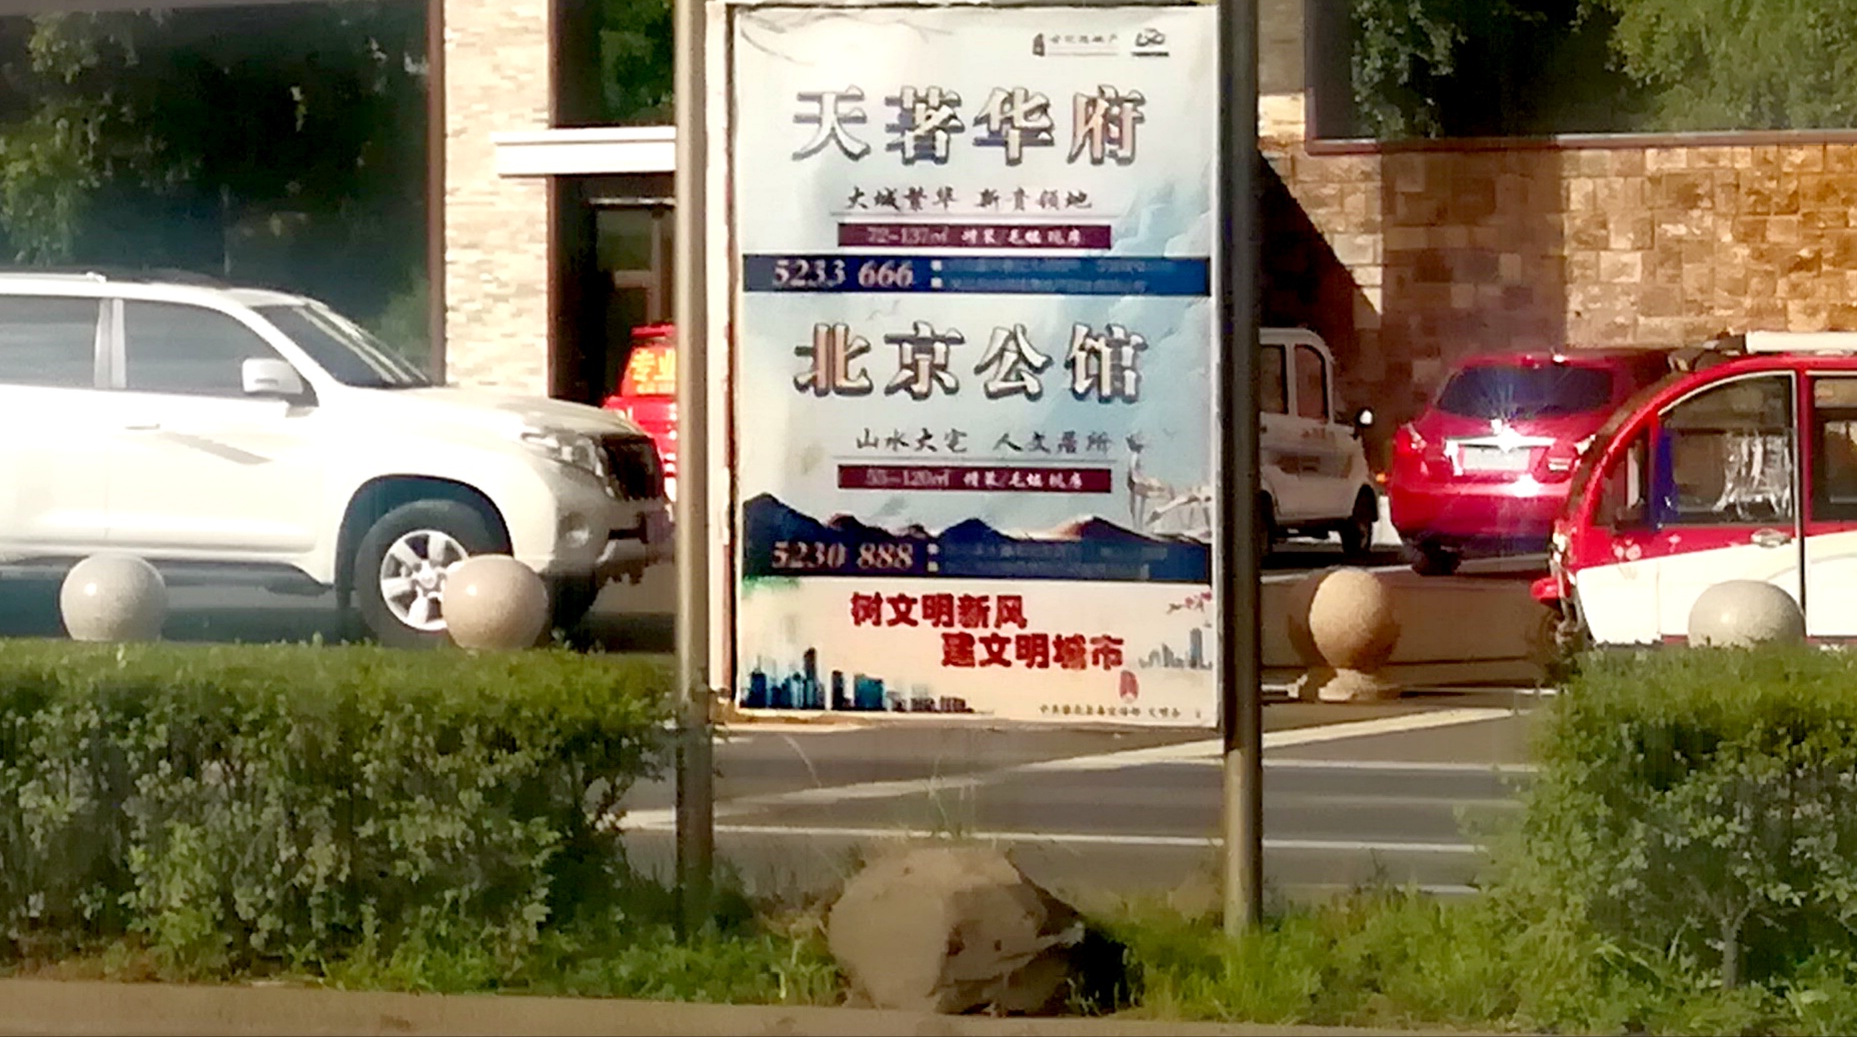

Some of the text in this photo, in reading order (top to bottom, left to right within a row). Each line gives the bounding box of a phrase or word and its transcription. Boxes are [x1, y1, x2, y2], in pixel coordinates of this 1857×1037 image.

[772, 259, 846, 288] 5233
[857, 260, 914, 288] 666
[794, 321, 1147, 404] 北京公馆
[772, 541, 846, 569] 5230
[857, 541, 914, 569] 888
[850, 591, 1028, 629] 树文明新风
[941, 631, 1124, 670] 建文明城市
